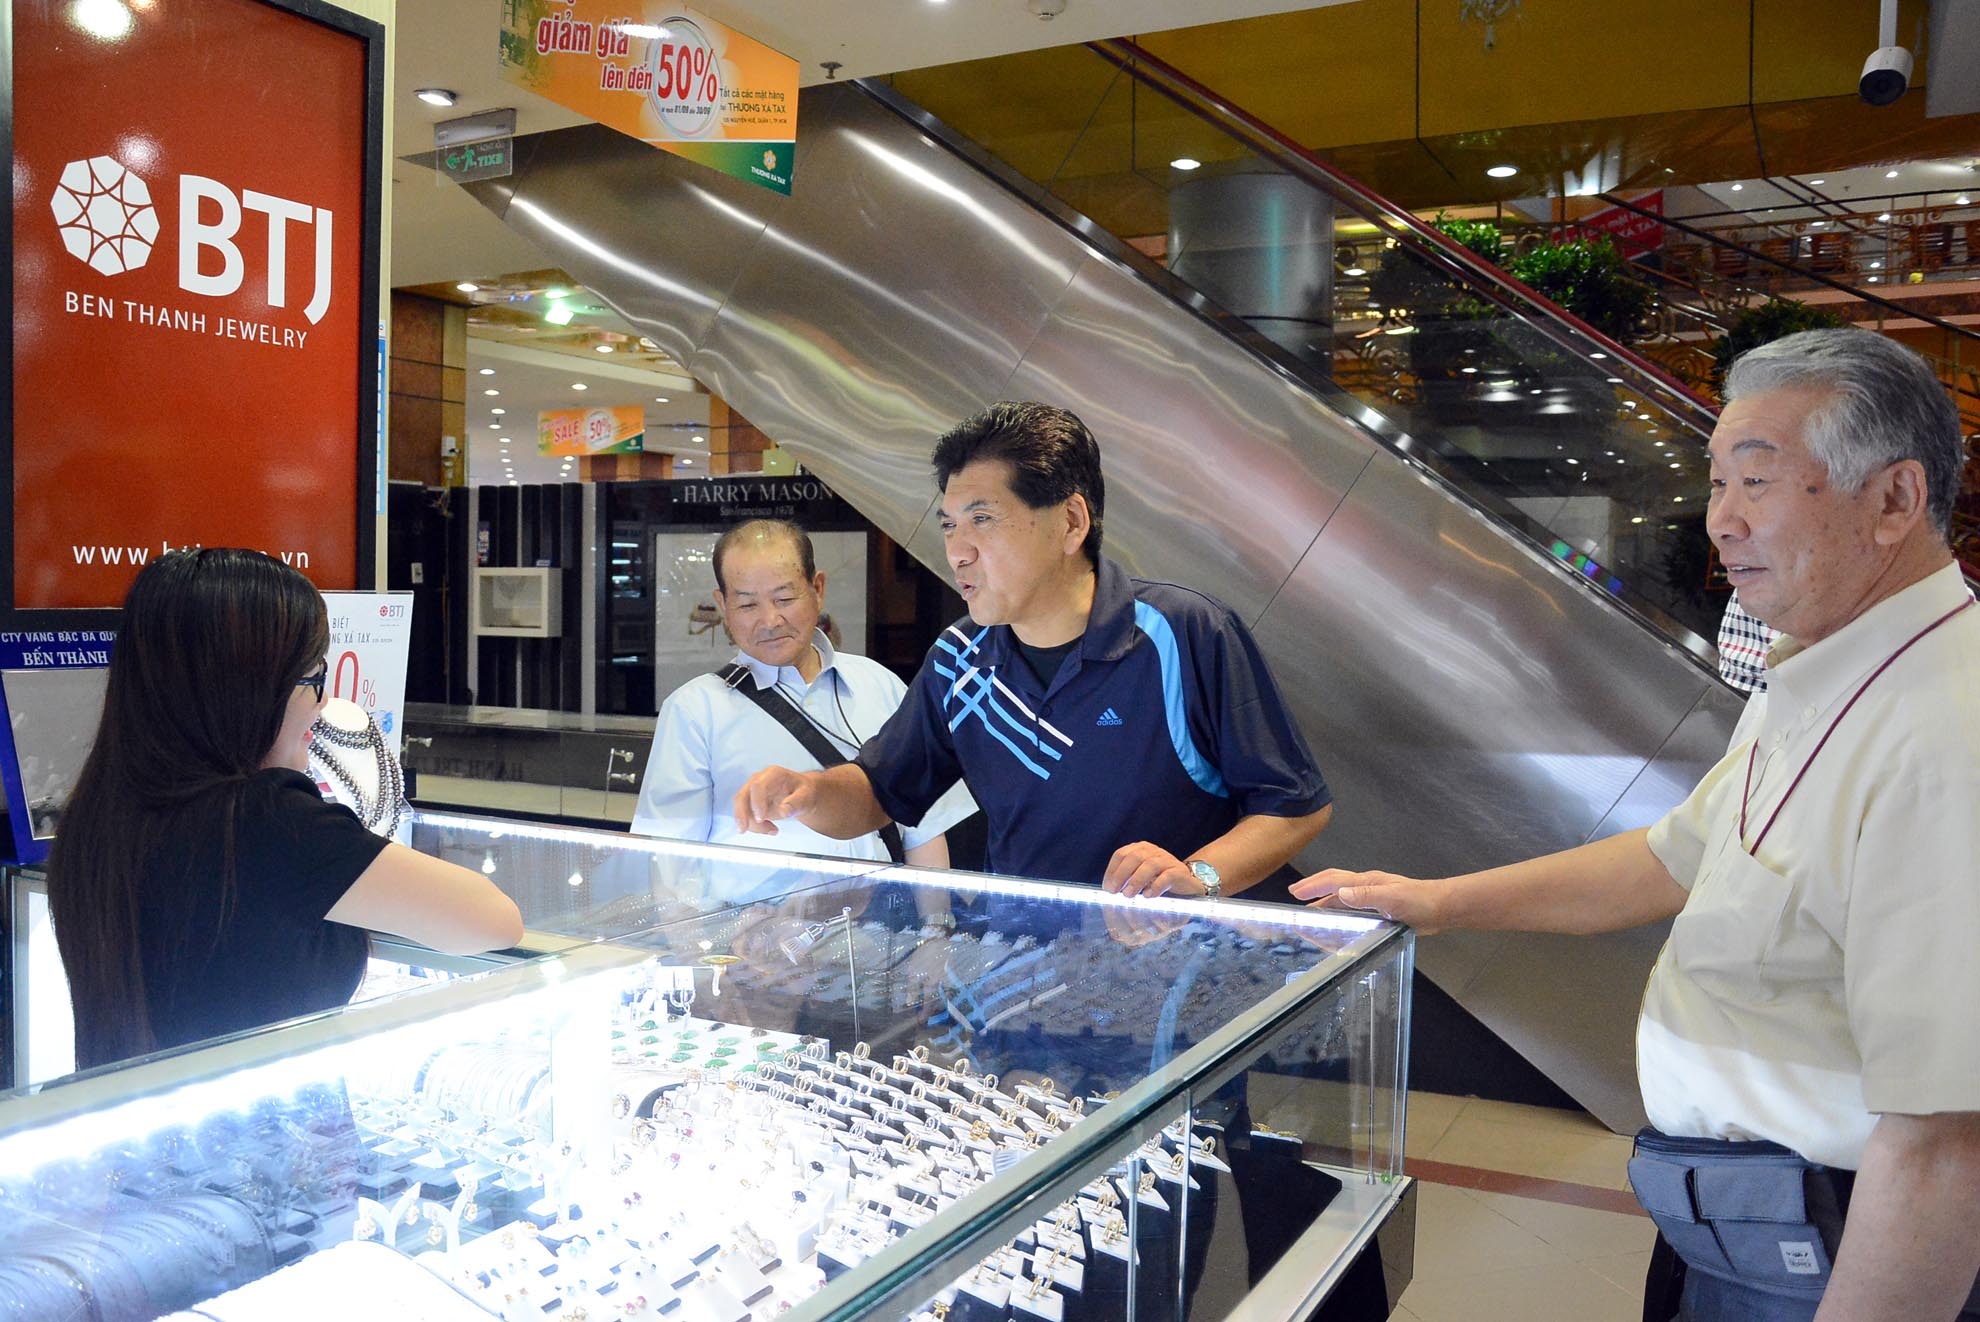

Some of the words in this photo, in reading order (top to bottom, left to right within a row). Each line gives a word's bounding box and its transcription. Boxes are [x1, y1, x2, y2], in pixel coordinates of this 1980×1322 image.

[537, 11, 591, 53] giảm
[602, 63, 623, 89] lên
[628, 63, 652, 90] đến
[658, 43, 718, 103] 50%
[179, 174, 333, 325] BTJ
[65, 291, 114, 319] BEN
[123, 300, 206, 334] THANH
[215, 317, 308, 350] JEWELRY
[554, 420, 580, 443] SALE
[684, 484, 752, 503] HARRY
[760, 482, 833, 500] MASON
[389, 605, 404, 618] BTJ
[1, 632, 21, 643] CTY
[358, 633, 371, 644] TAX
[22, 646, 55, 666] BẾN
[57, 647, 109, 665] THÀNH
[1096, 719, 1123, 727] adidas
